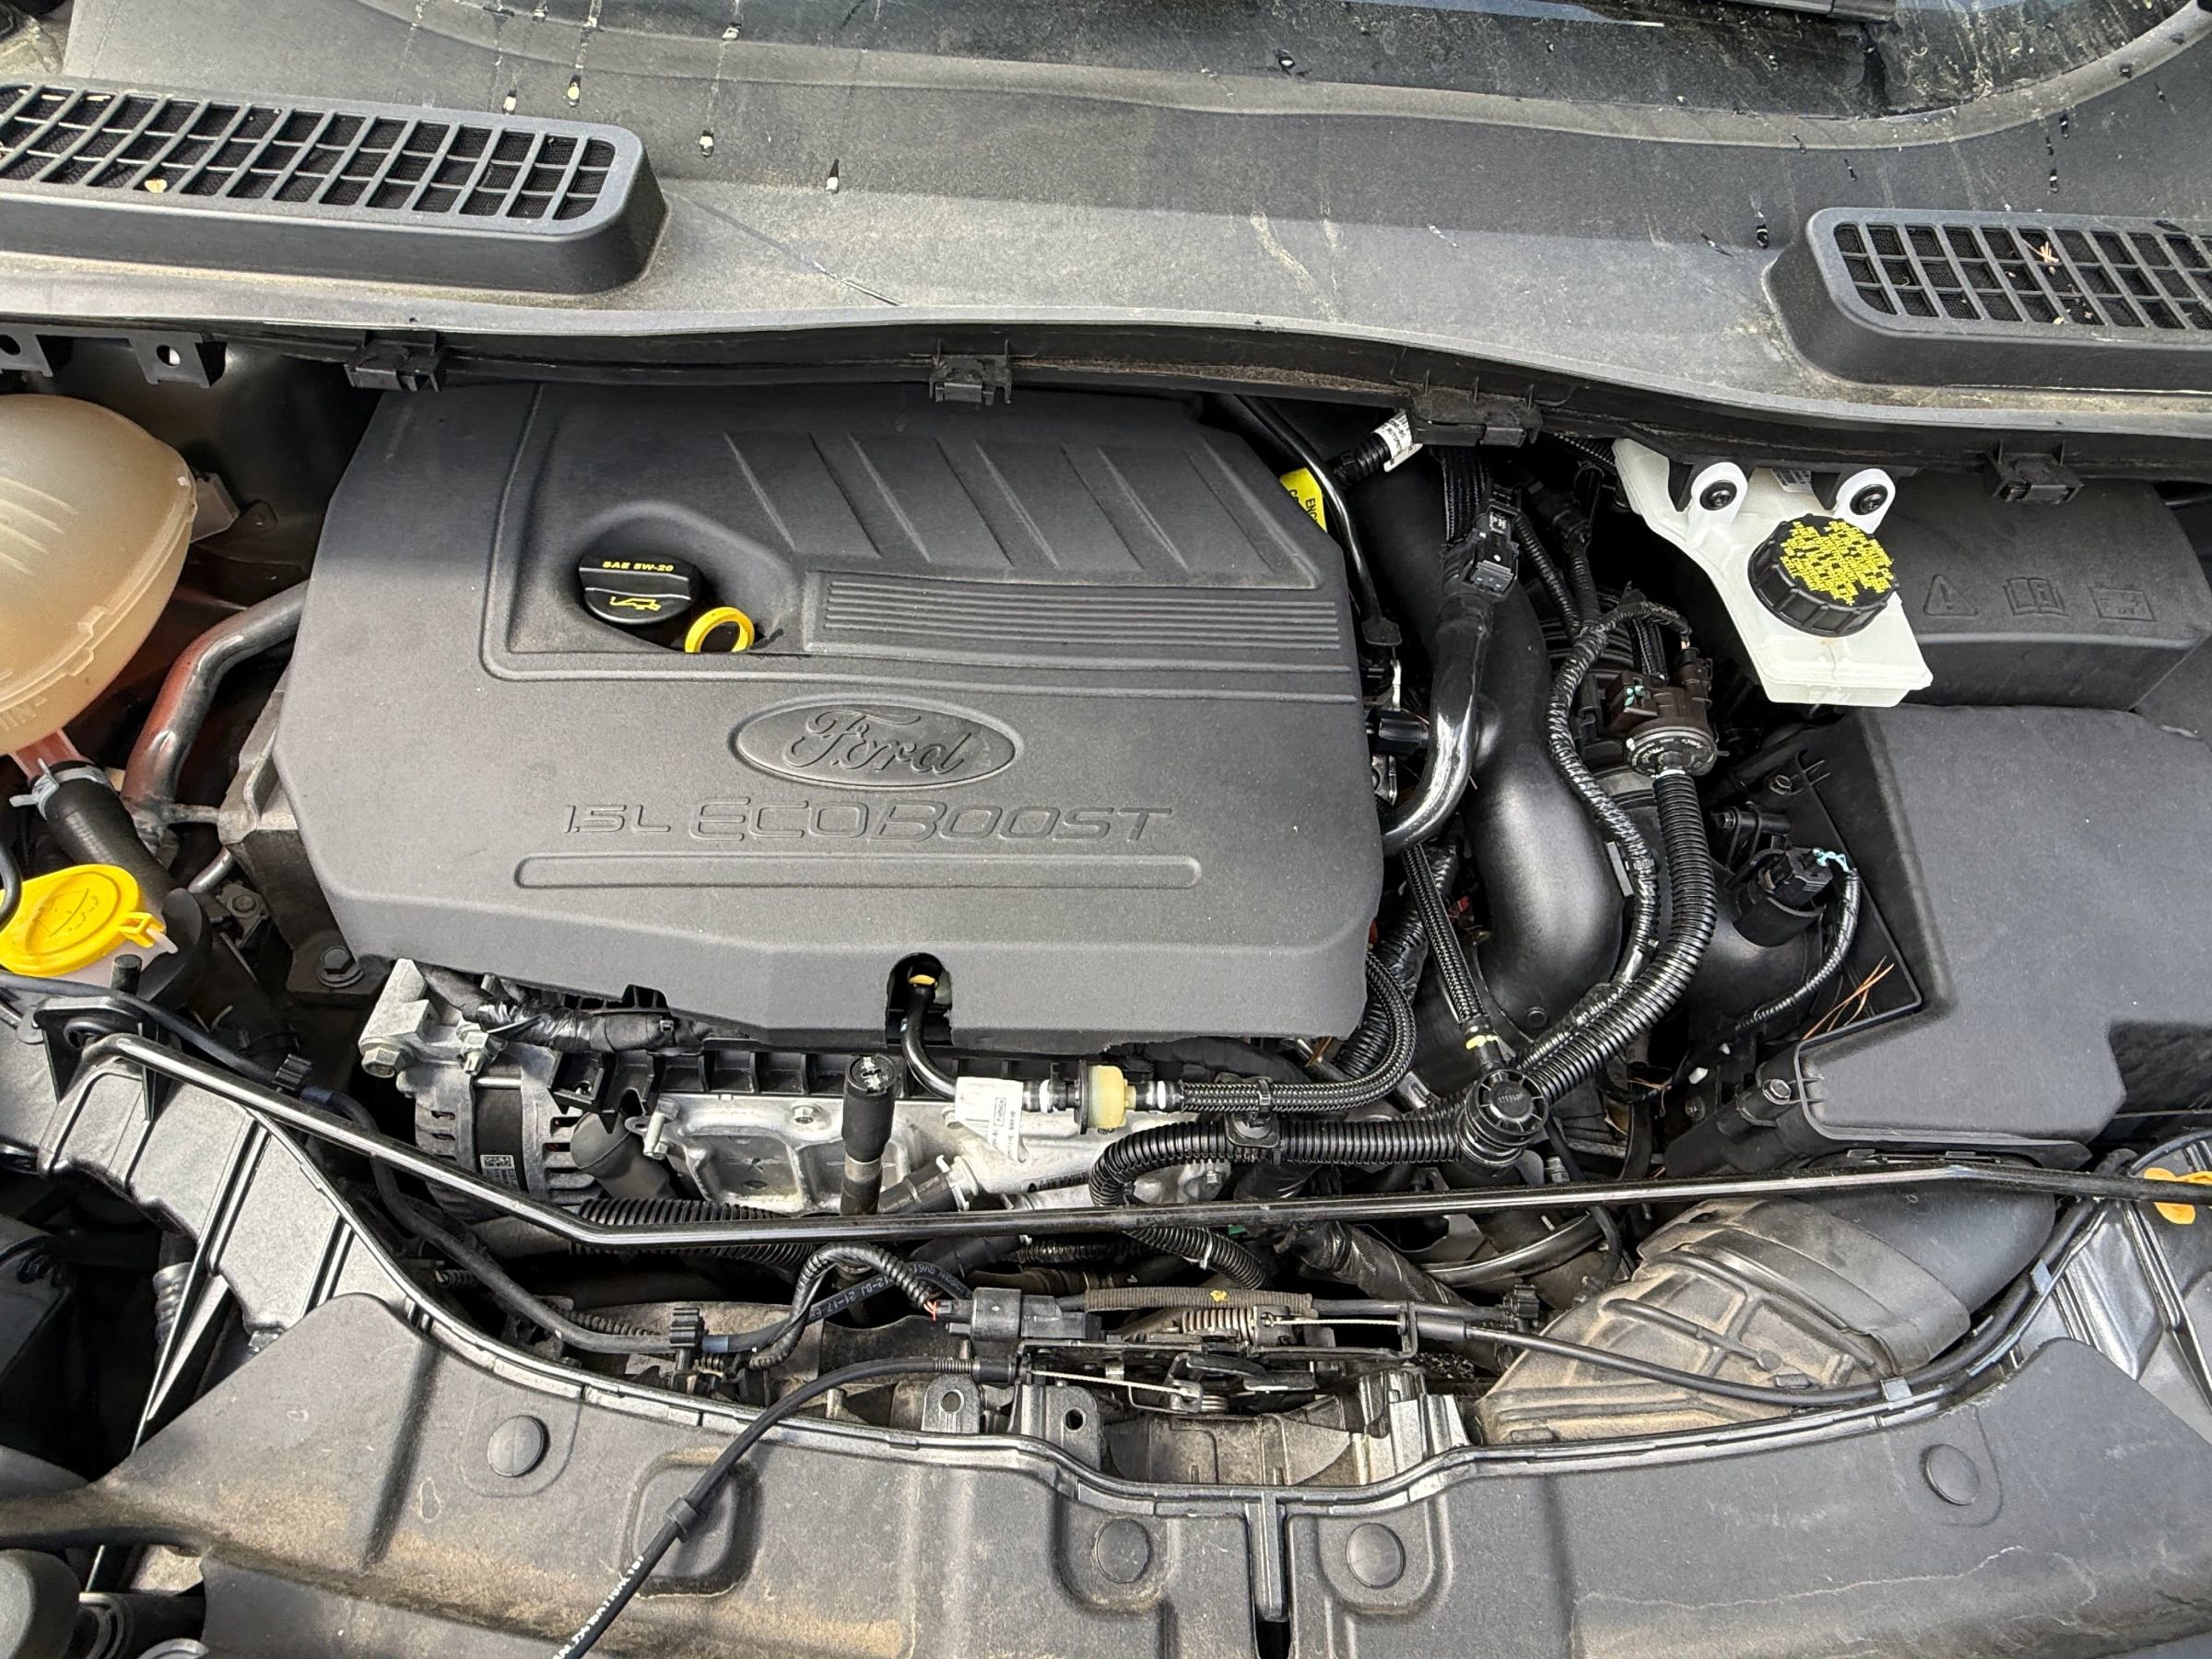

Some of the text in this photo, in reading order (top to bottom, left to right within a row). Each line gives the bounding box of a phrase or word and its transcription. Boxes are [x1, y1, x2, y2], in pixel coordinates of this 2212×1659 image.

[1786, 537, 1801, 549] DOT
[1793, 522, 1811, 538] AVANT
[1812, 548, 1825, 559] LE
[1829, 531, 1850, 554] SEALED
[1838, 520, 1859, 543] BEFORE
[602, 560, 675, 571] SAE 5W-20
[1826, 556, 1839, 565] LE
[1829, 521, 1845, 535] ONLY
[1839, 536, 1853, 547] DOT
[1853, 556, 1872, 574] FLUID
[1865, 574, 1885, 594] FROM
[1850, 525, 1894, 580] CLEAN FILLER CAP
[1790, 558, 1819, 591] CONTENANT
[1813, 565, 1827, 574] DU
[1832, 567, 1859, 596] BOUCHON
[783, 708, 973, 774] Ford
[564, 796, 1173, 842] 1.5L ECOBOOST
